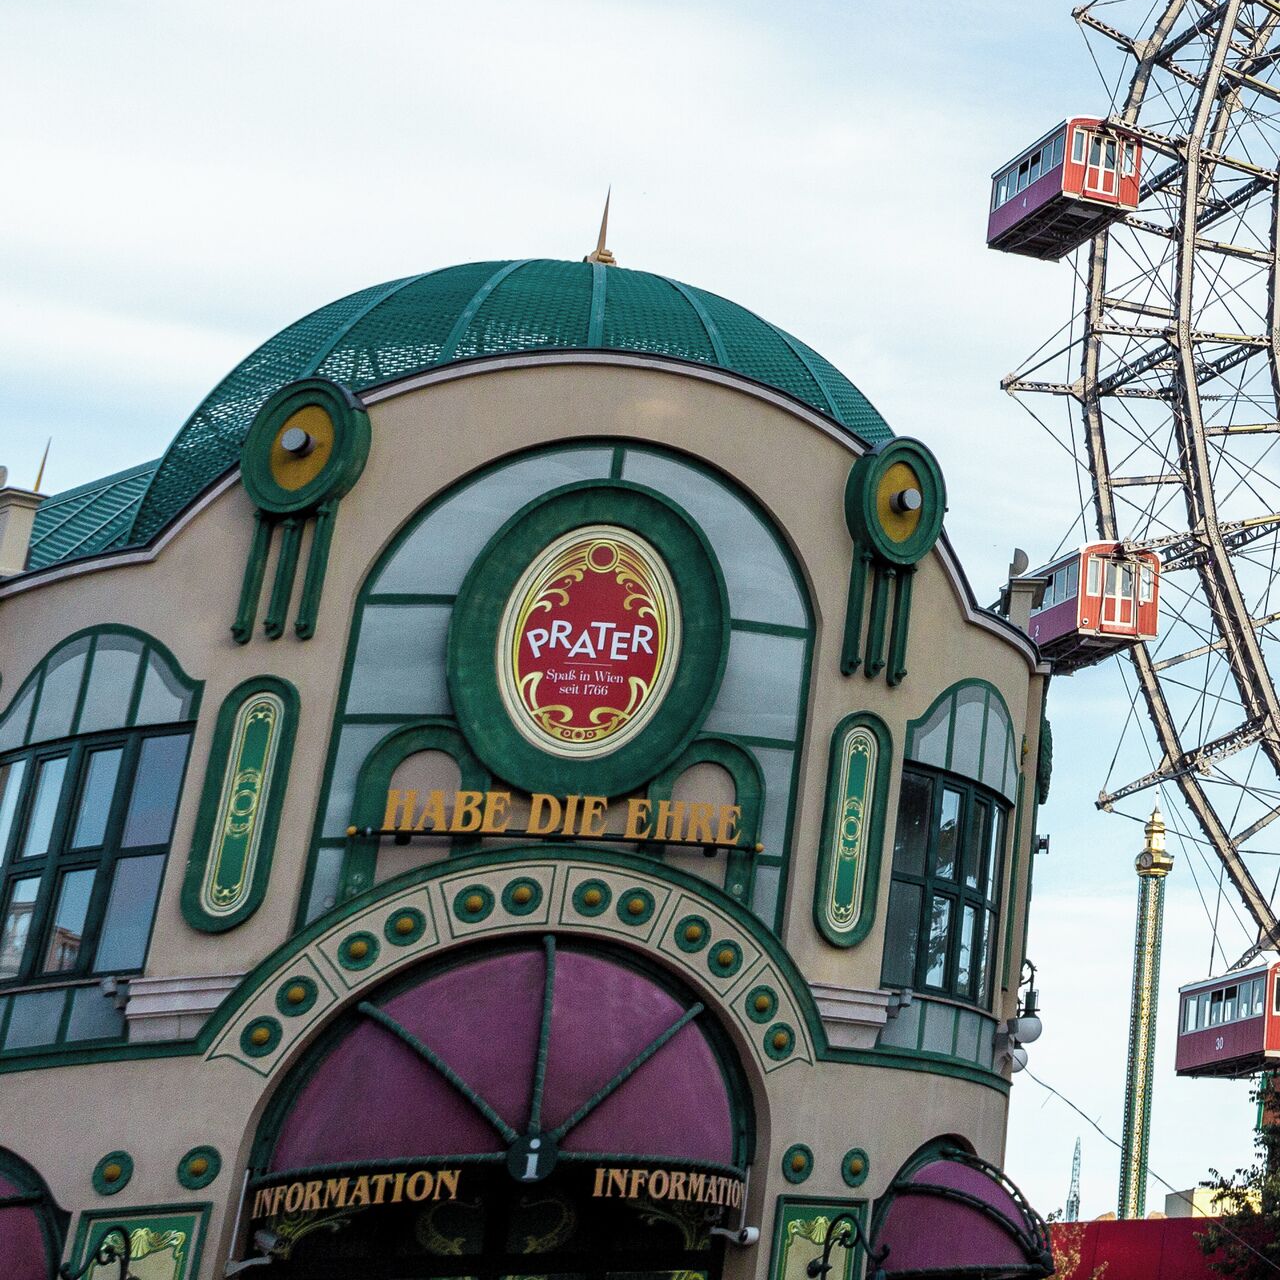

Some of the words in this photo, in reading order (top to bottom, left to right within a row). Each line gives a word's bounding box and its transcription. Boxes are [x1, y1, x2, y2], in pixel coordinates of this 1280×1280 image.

[526, 619, 654, 661] PRATER
[546, 668, 577, 683] Spaß
[579, 670, 591, 682] in
[594, 670, 624, 684] Wien
[559, 683, 579, 695] seit
[583, 684, 609, 696] 1766
[381, 789, 513, 833] HABE
[526, 793, 609, 837] DIE
[624, 798, 743, 846] EHRE
[1215, 1036, 1225, 1051] 30
[252, 1169, 462, 1220] INFORMATION
